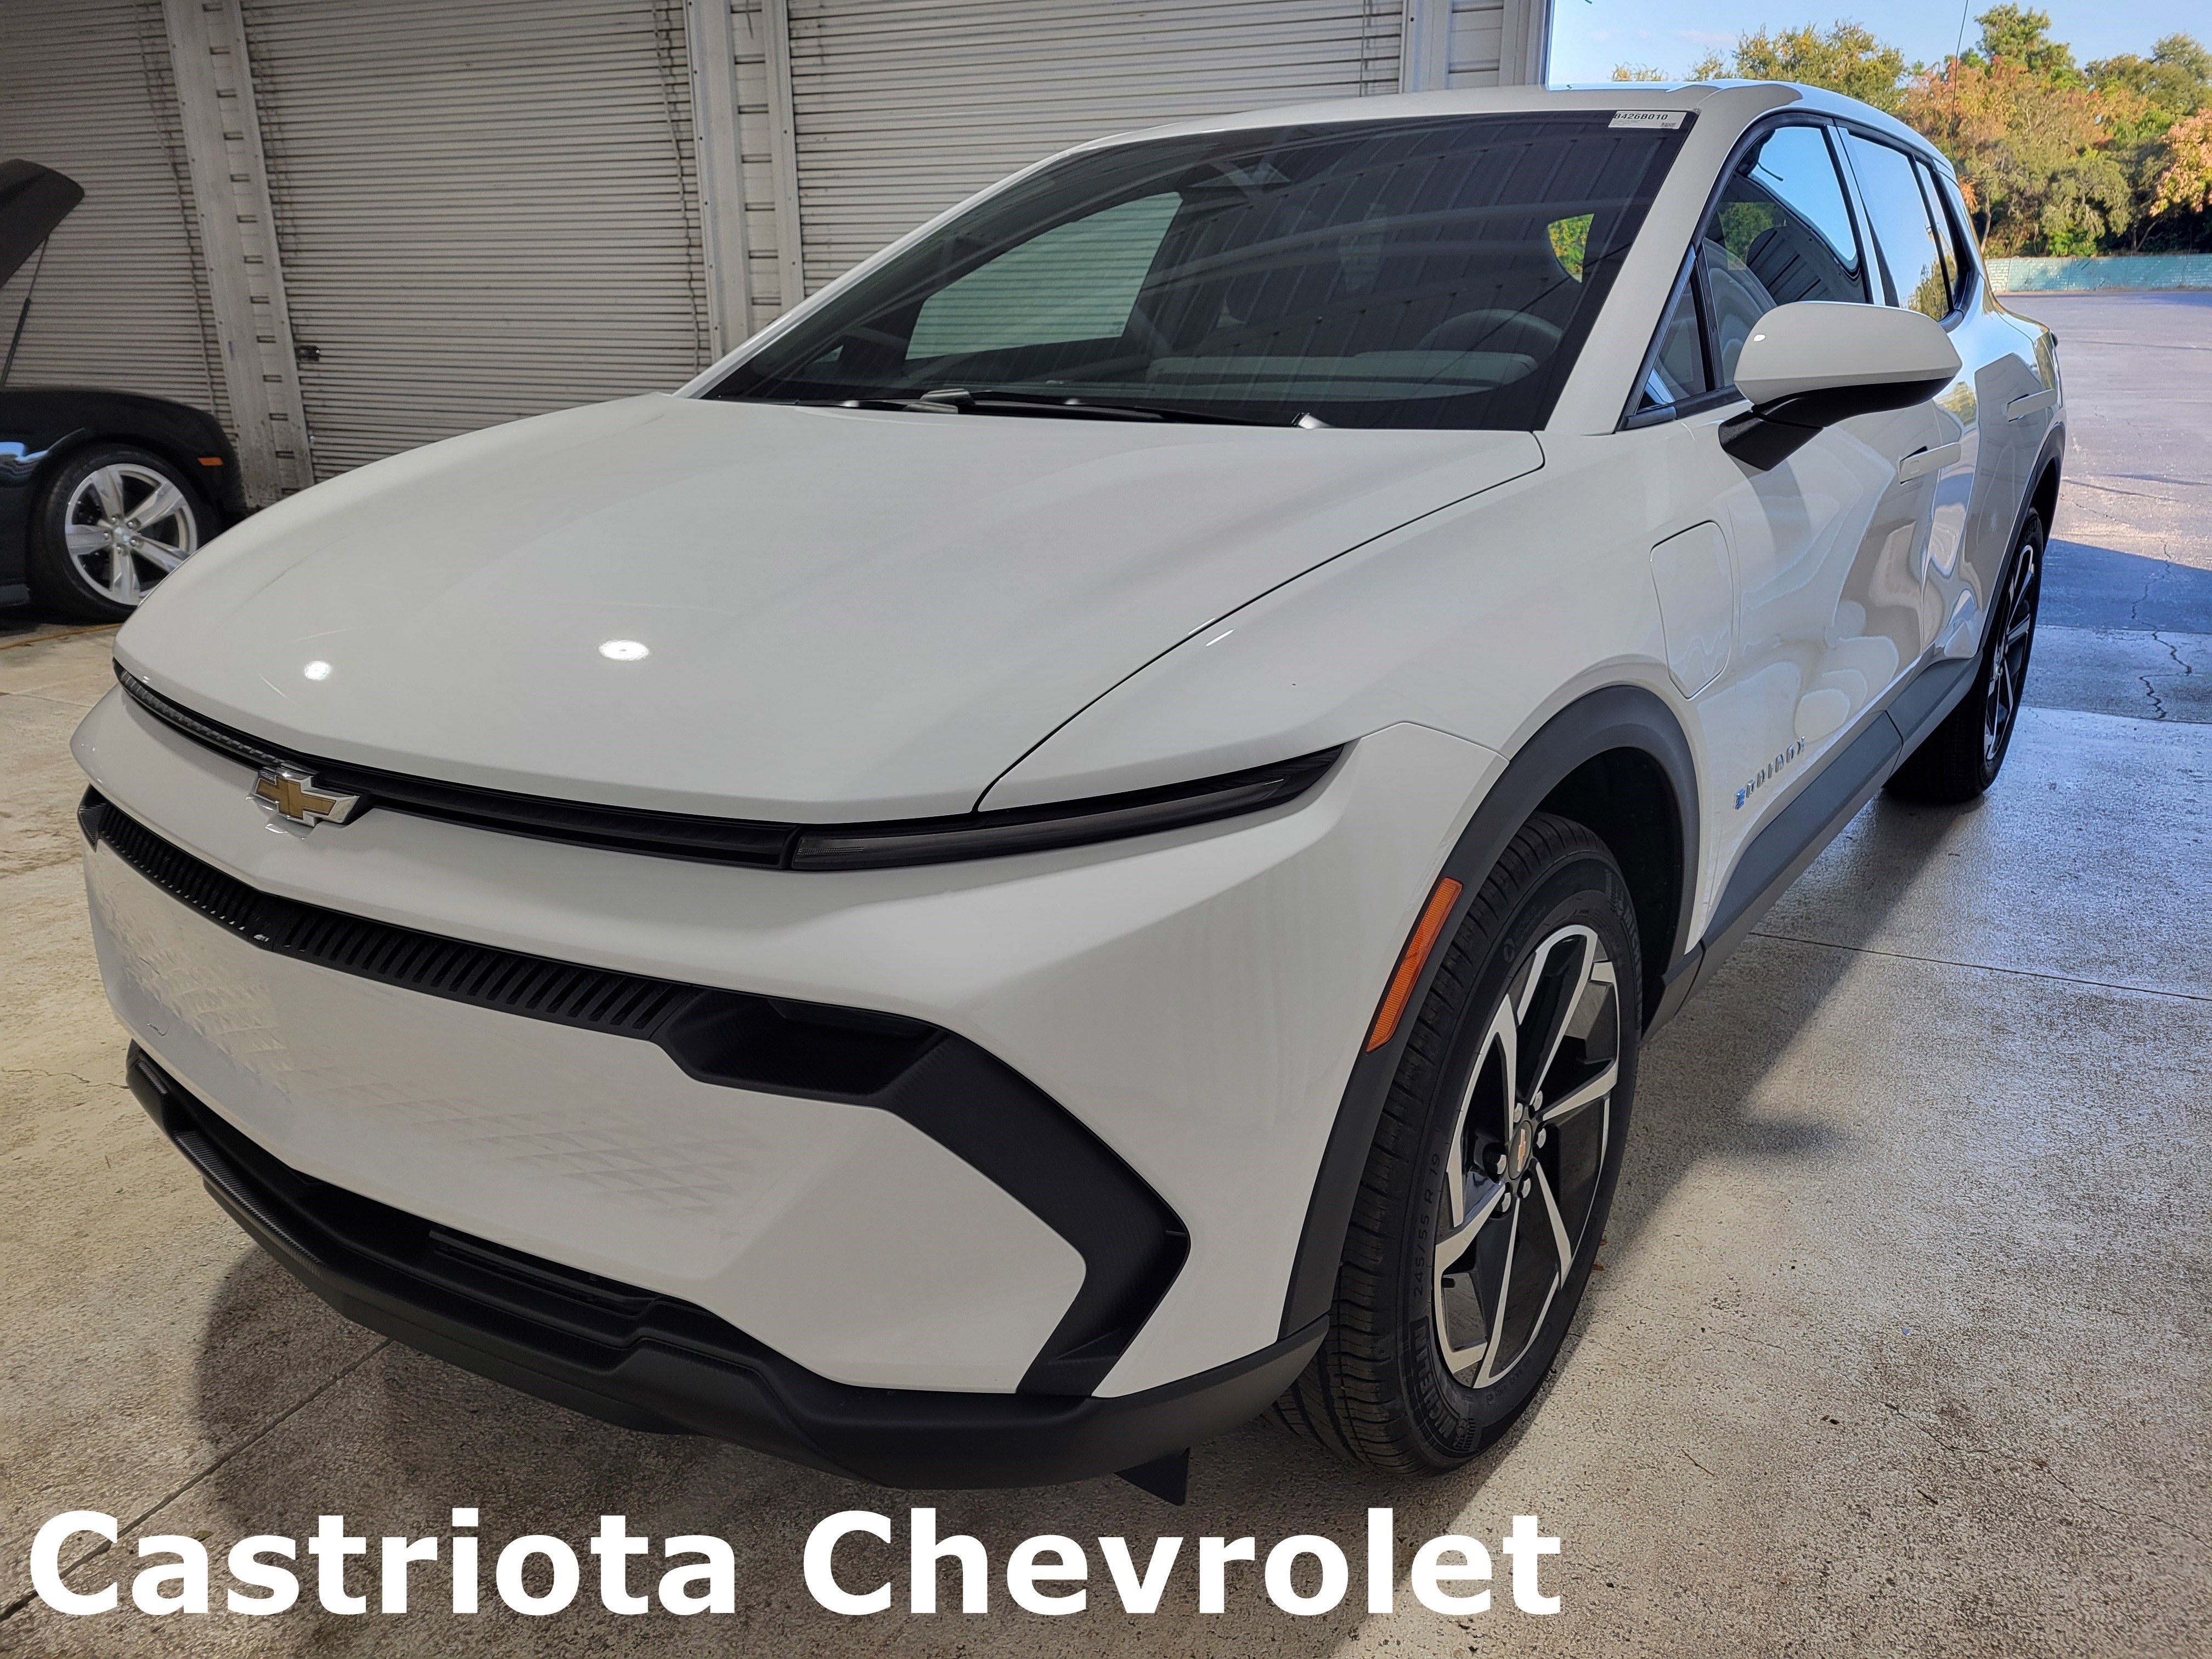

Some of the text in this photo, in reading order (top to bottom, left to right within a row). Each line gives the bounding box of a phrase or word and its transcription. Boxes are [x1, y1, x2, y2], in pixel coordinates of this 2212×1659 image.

[1413, 1153, 1440, 1296] 245/55 R 19
[1414, 1324, 1457, 1440] MICHELIN
